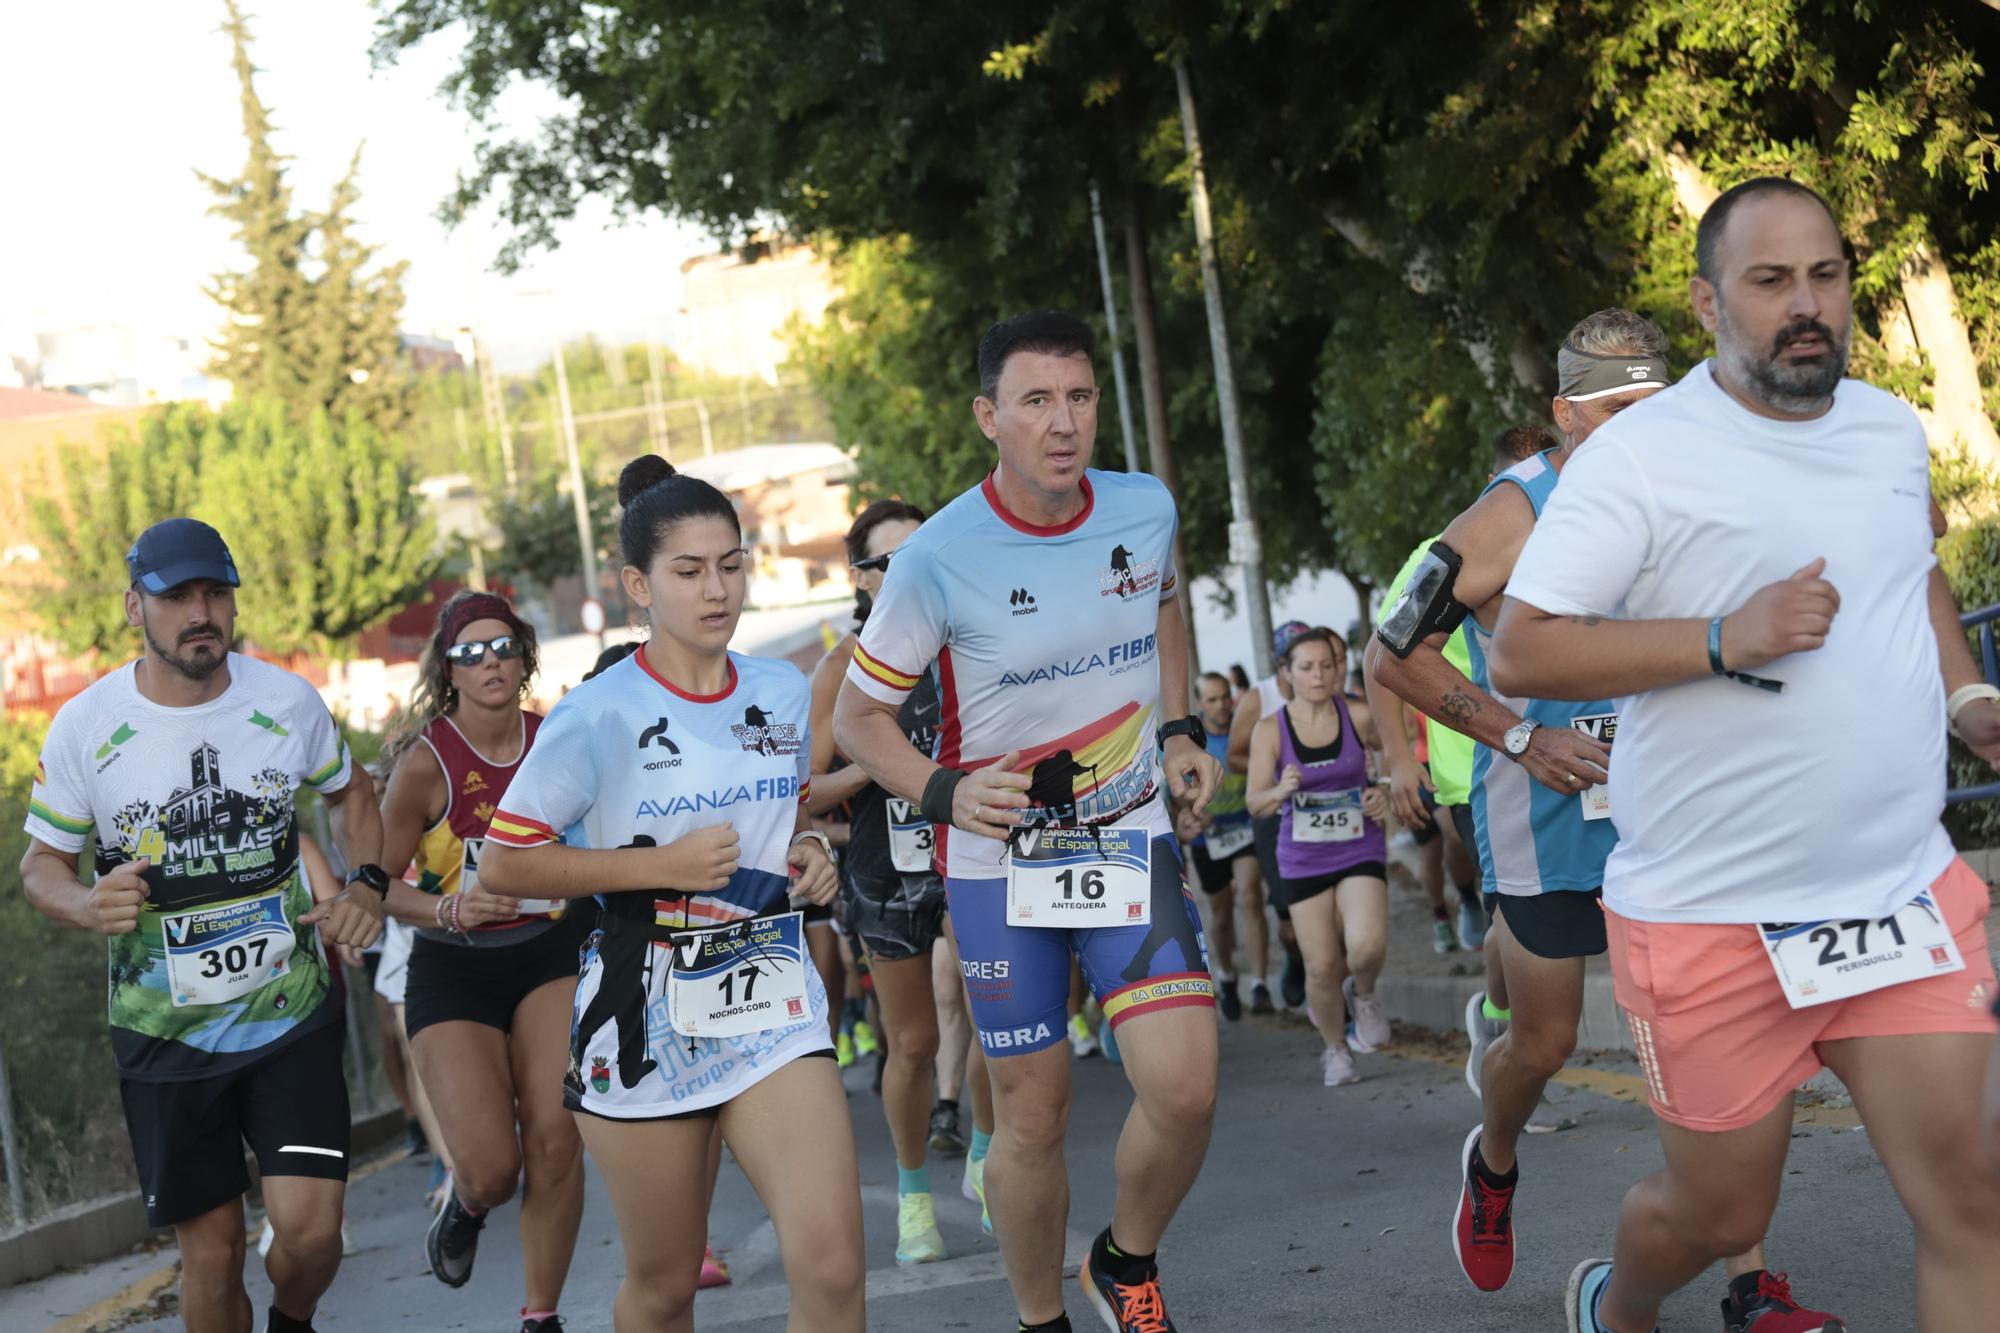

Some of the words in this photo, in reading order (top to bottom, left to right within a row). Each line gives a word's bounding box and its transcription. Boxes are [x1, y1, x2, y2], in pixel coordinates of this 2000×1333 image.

[1012, 606, 1038, 617] mobel
[999, 654, 1106, 687] AVANZA
[636, 785, 752, 820] AVANZA
[890, 801, 909, 824] V
[1310, 812, 1349, 828] 245
[136, 827, 167, 866] 4
[167, 826, 273, 862] MILLAS
[1017, 829, 1040, 857] V
[1041, 837, 1055, 849] El
[1083, 830, 1120, 839] POULAR
[165, 863, 184, 877] DE
[186, 856, 218, 877] LA
[225, 847, 276, 872] RAYA
[228, 875, 237, 883] V
[1055, 869, 1105, 900] 16
[192, 910, 232, 923] CARRERA
[231, 902, 261, 914] POPULAR
[166, 916, 191, 944] V
[193, 922, 207, 934] El
[705, 943, 716, 956] El
[715, 927, 783, 954] Esparagal
[1808, 915, 1906, 966] 271
[199, 938, 269, 979] 307
[1836, 951, 1903, 974] PERIQUILLO
[227, 973, 249, 984] JUAN
[718, 966, 760, 1006] 17
[1132, 989, 1149, 1003] LA
[709, 1001, 771, 1020] NOCHOS-CORO
[979, 1022, 1051, 1049] FIBRA
[671, 1059, 736, 1102] Grupo
